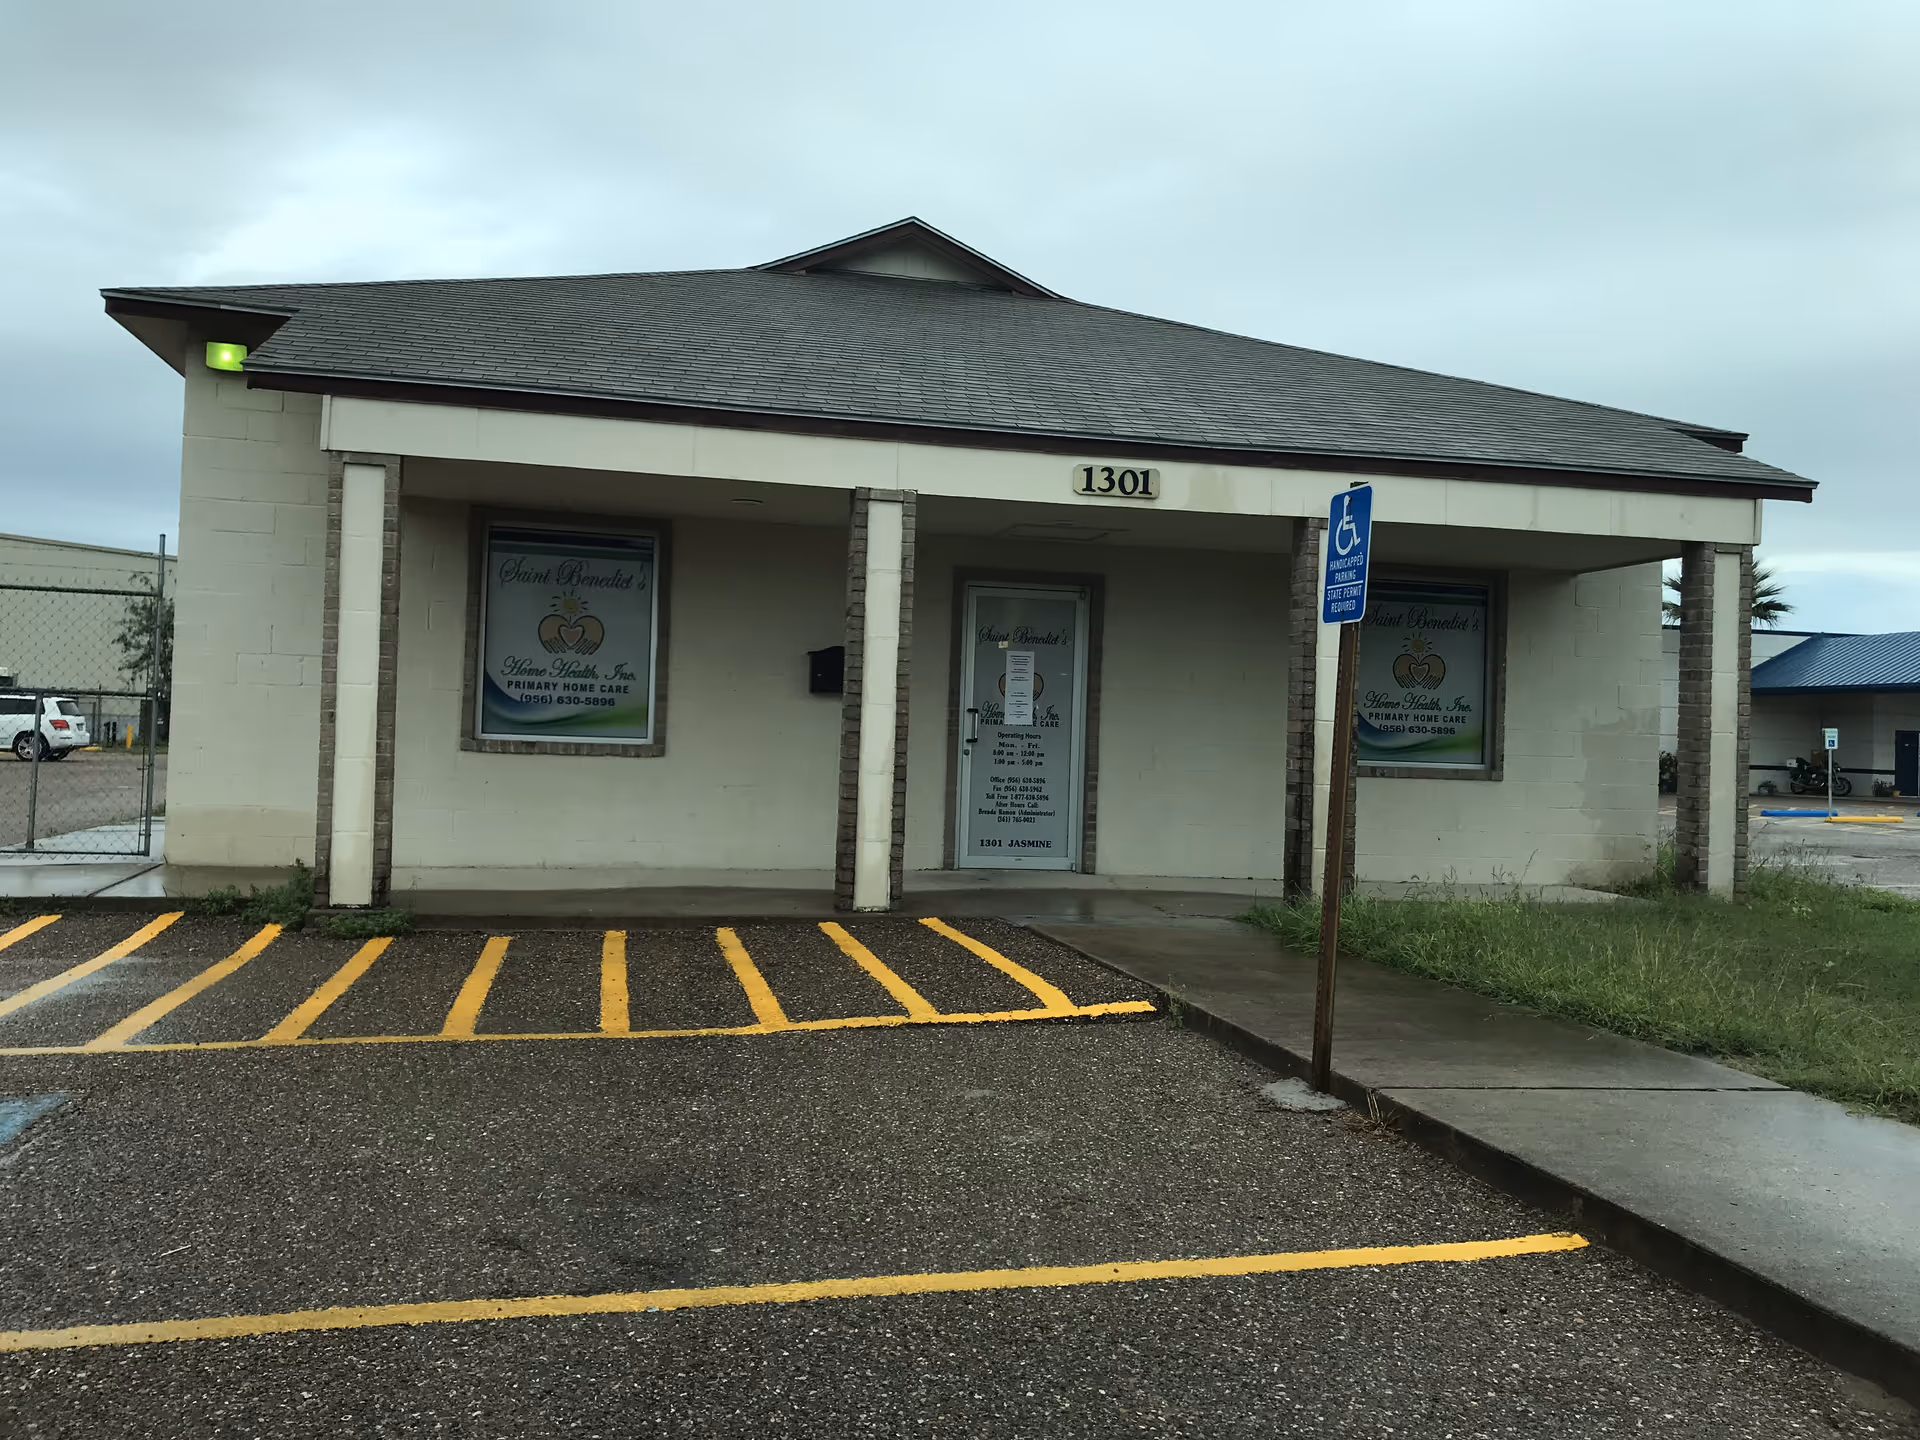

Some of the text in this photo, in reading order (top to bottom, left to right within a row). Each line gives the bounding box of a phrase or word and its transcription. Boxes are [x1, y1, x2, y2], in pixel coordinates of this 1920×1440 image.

[1082, 467, 1152, 495] 1301
[1329, 554, 1364, 571] HANDICAPPED
[500, 556, 551, 588] Saint
[1334, 569, 1357, 583] PARKING
[1327, 585, 1362, 600] STATE PERMIT
[1330, 600, 1356, 613] REQUIRED
[979, 624, 1009, 643] Saint
[501, 655, 637, 681] Home Health, Inc.
[507, 680, 629, 694] PRIMARY HOME CARE
[519, 694, 615, 707] (956) 630-5896
[1363, 690, 1472, 712] Home Health, Inc.
[1040, 704, 1060, 720] Inc.
[1368, 712, 1466, 724] PRIMARY HOME CARE
[997, 731, 1041, 740] Operating Hours
[1378, 723, 1456, 735] (956) 630-5896
[1007, 776, 1020, 784] (956)
[1004, 785, 1017, 793] (956)
[980, 839, 1052, 848] 1301 JASMINE
